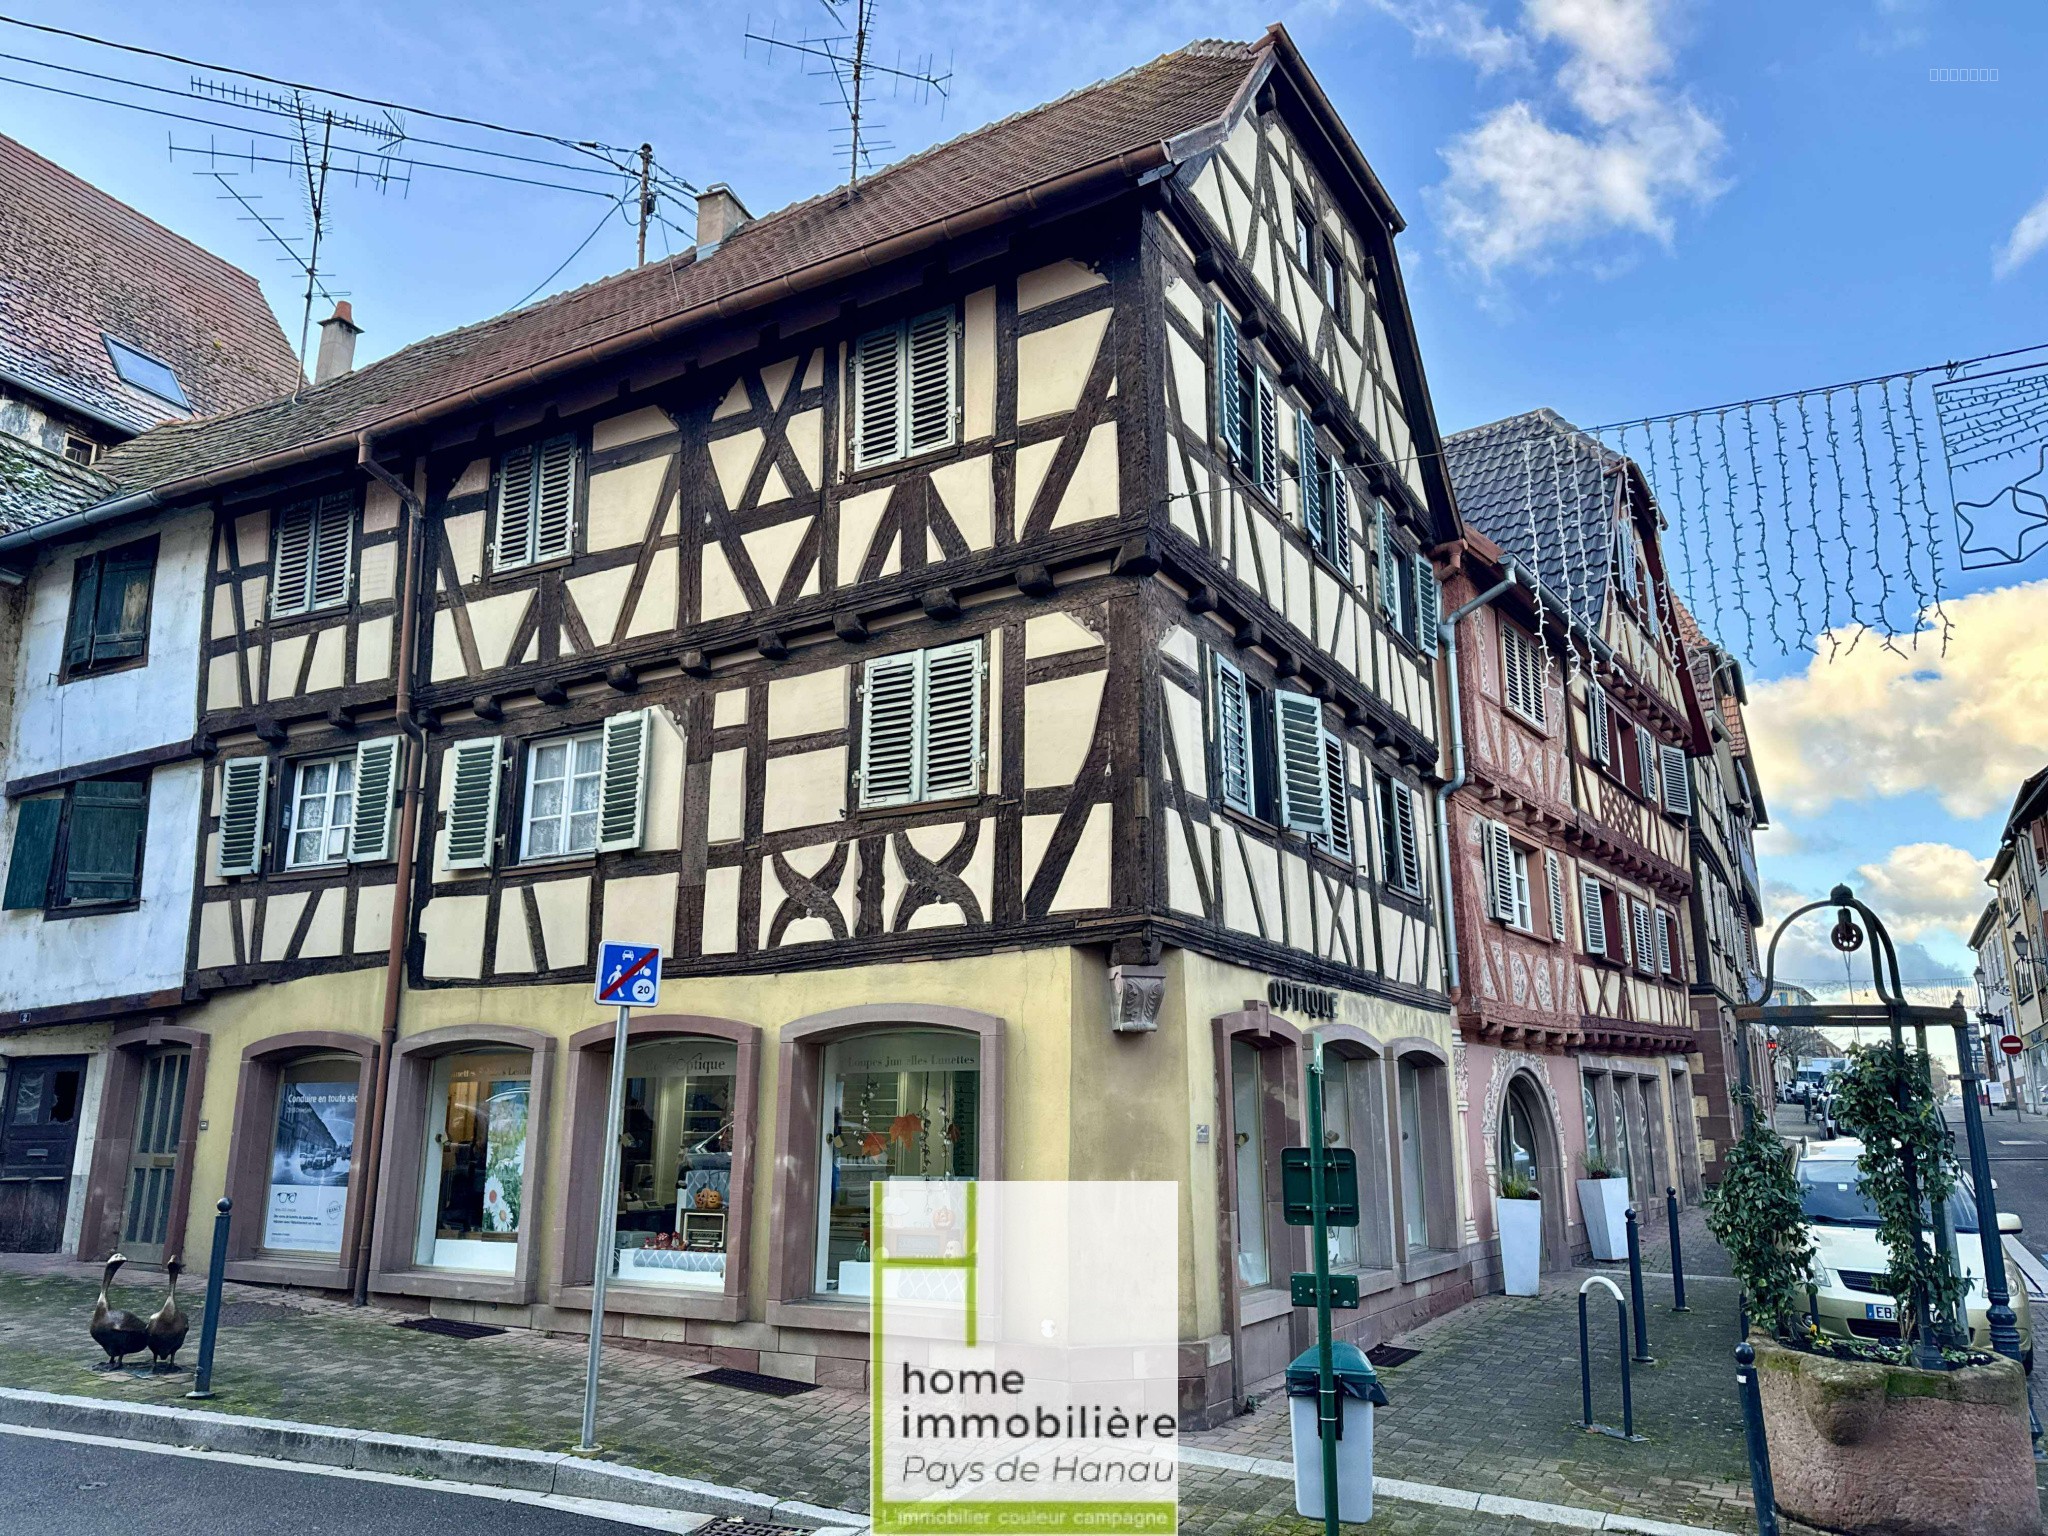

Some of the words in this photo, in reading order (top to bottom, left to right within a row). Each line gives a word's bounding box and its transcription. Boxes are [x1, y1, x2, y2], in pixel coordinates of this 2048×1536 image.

[637, 985, 650, 994] 20
[1267, 979, 1339, 1020] OPTIQUE
[931, 1054, 975, 1065] Lunettes
[287, 1093, 317, 1103] Conduire
[317, 1095, 327, 1103] en
[328, 1094, 346, 1103] toute
